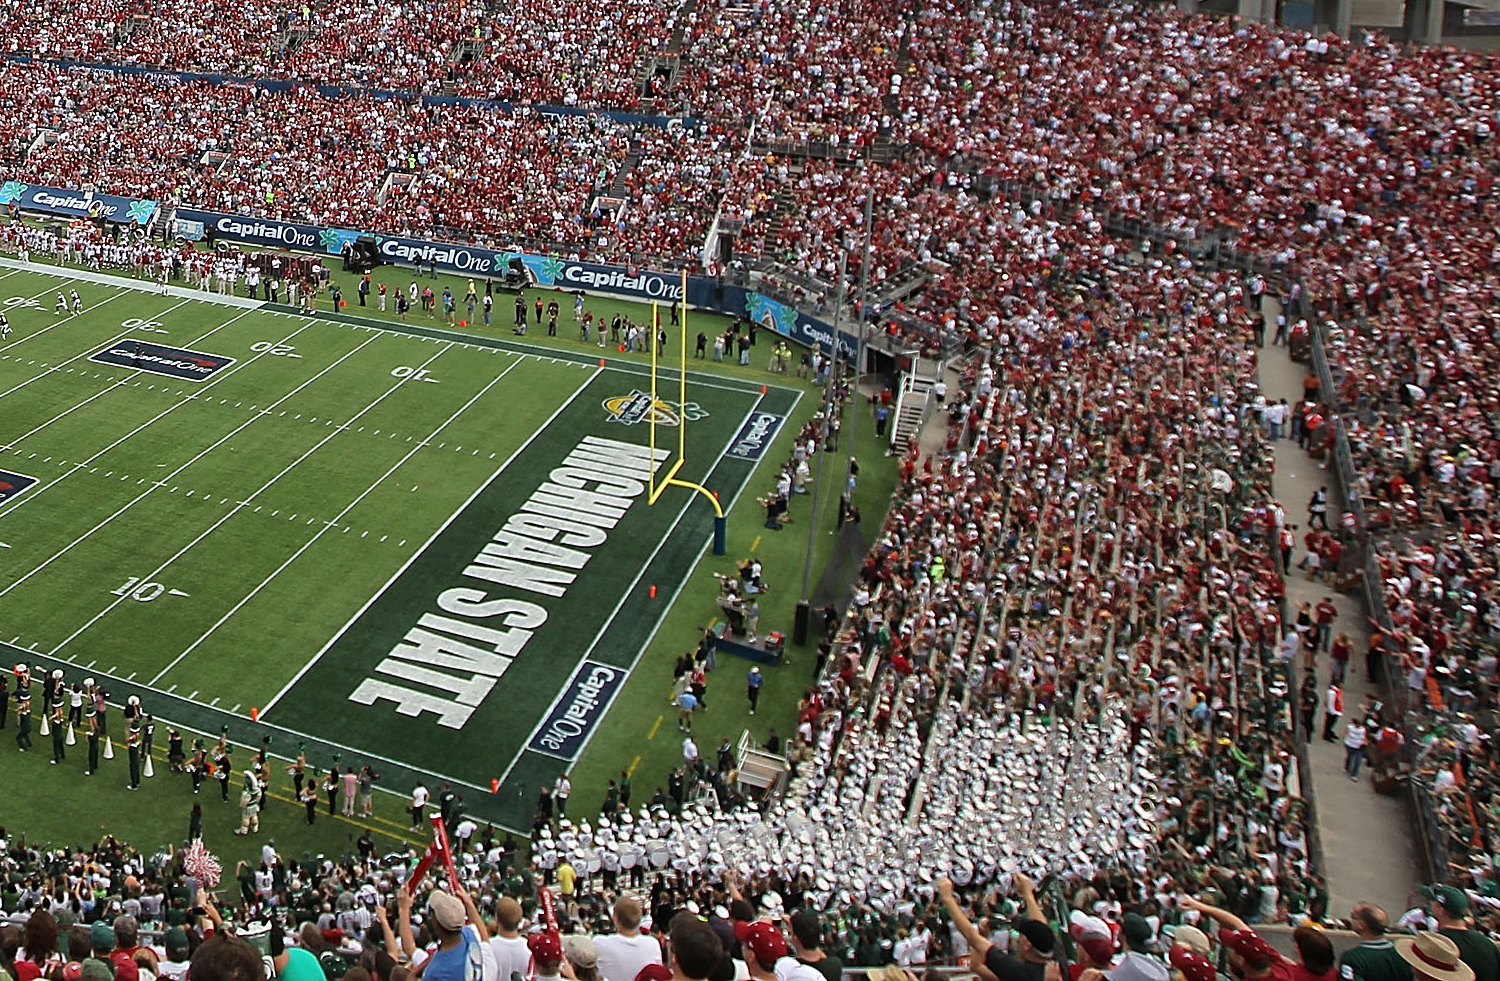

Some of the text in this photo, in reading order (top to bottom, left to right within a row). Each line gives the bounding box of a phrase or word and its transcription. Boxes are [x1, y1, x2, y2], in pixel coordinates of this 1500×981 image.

[31, 191, 118, 218] CapitalOne
[216, 218, 316, 247] CapitalOne
[380, 239, 491, 273] CapitalOne
[564, 266, 684, 300] CapitalOne
[732, 414, 777, 458] CapitalOne
[110, 576, 166, 603] 10
[348, 435, 672, 731] MICHIGAN STATE
[540, 666, 616, 751] CapitalOne
